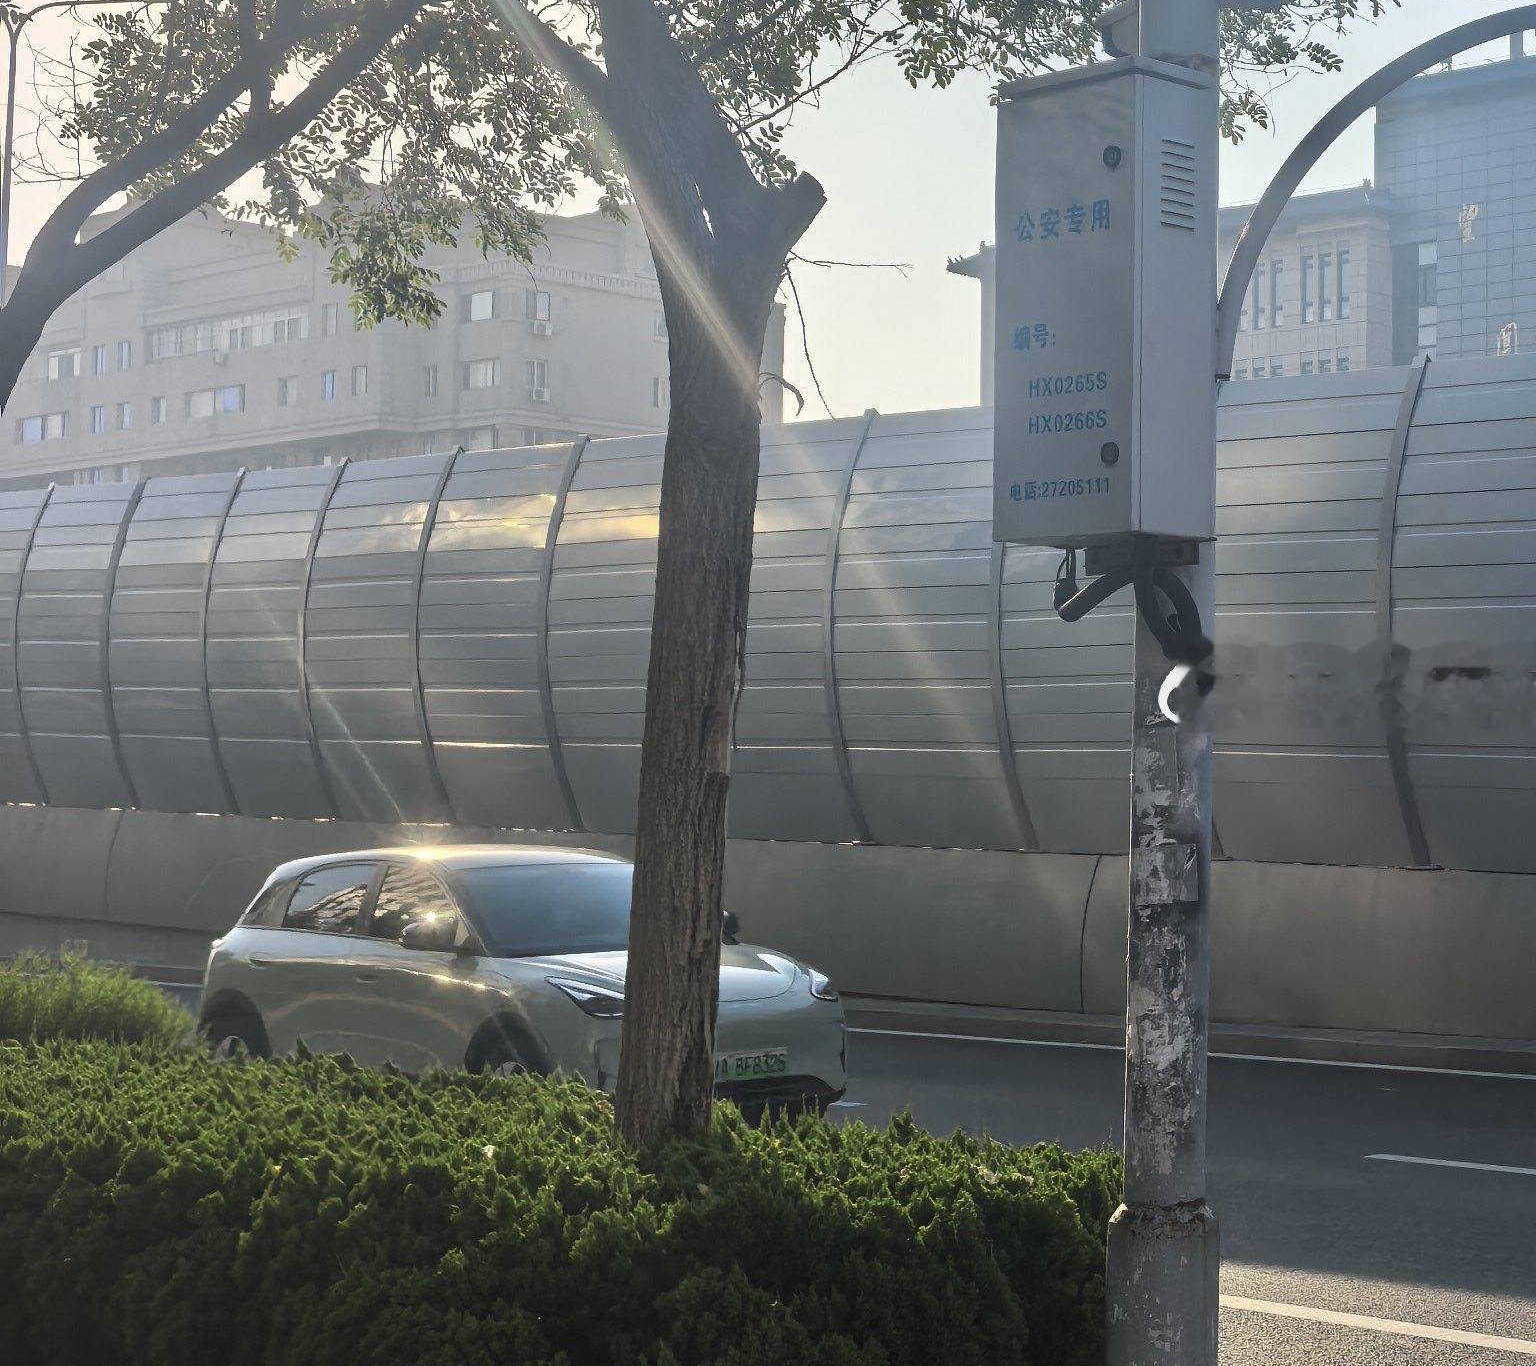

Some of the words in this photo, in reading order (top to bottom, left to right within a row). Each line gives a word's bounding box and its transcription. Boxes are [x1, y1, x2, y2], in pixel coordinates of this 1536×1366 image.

[1016, 199, 1111, 242] 公安专用
[1028, 371, 1108, 398] HX0265S
[1028, 409, 1108, 434] HX0266S
